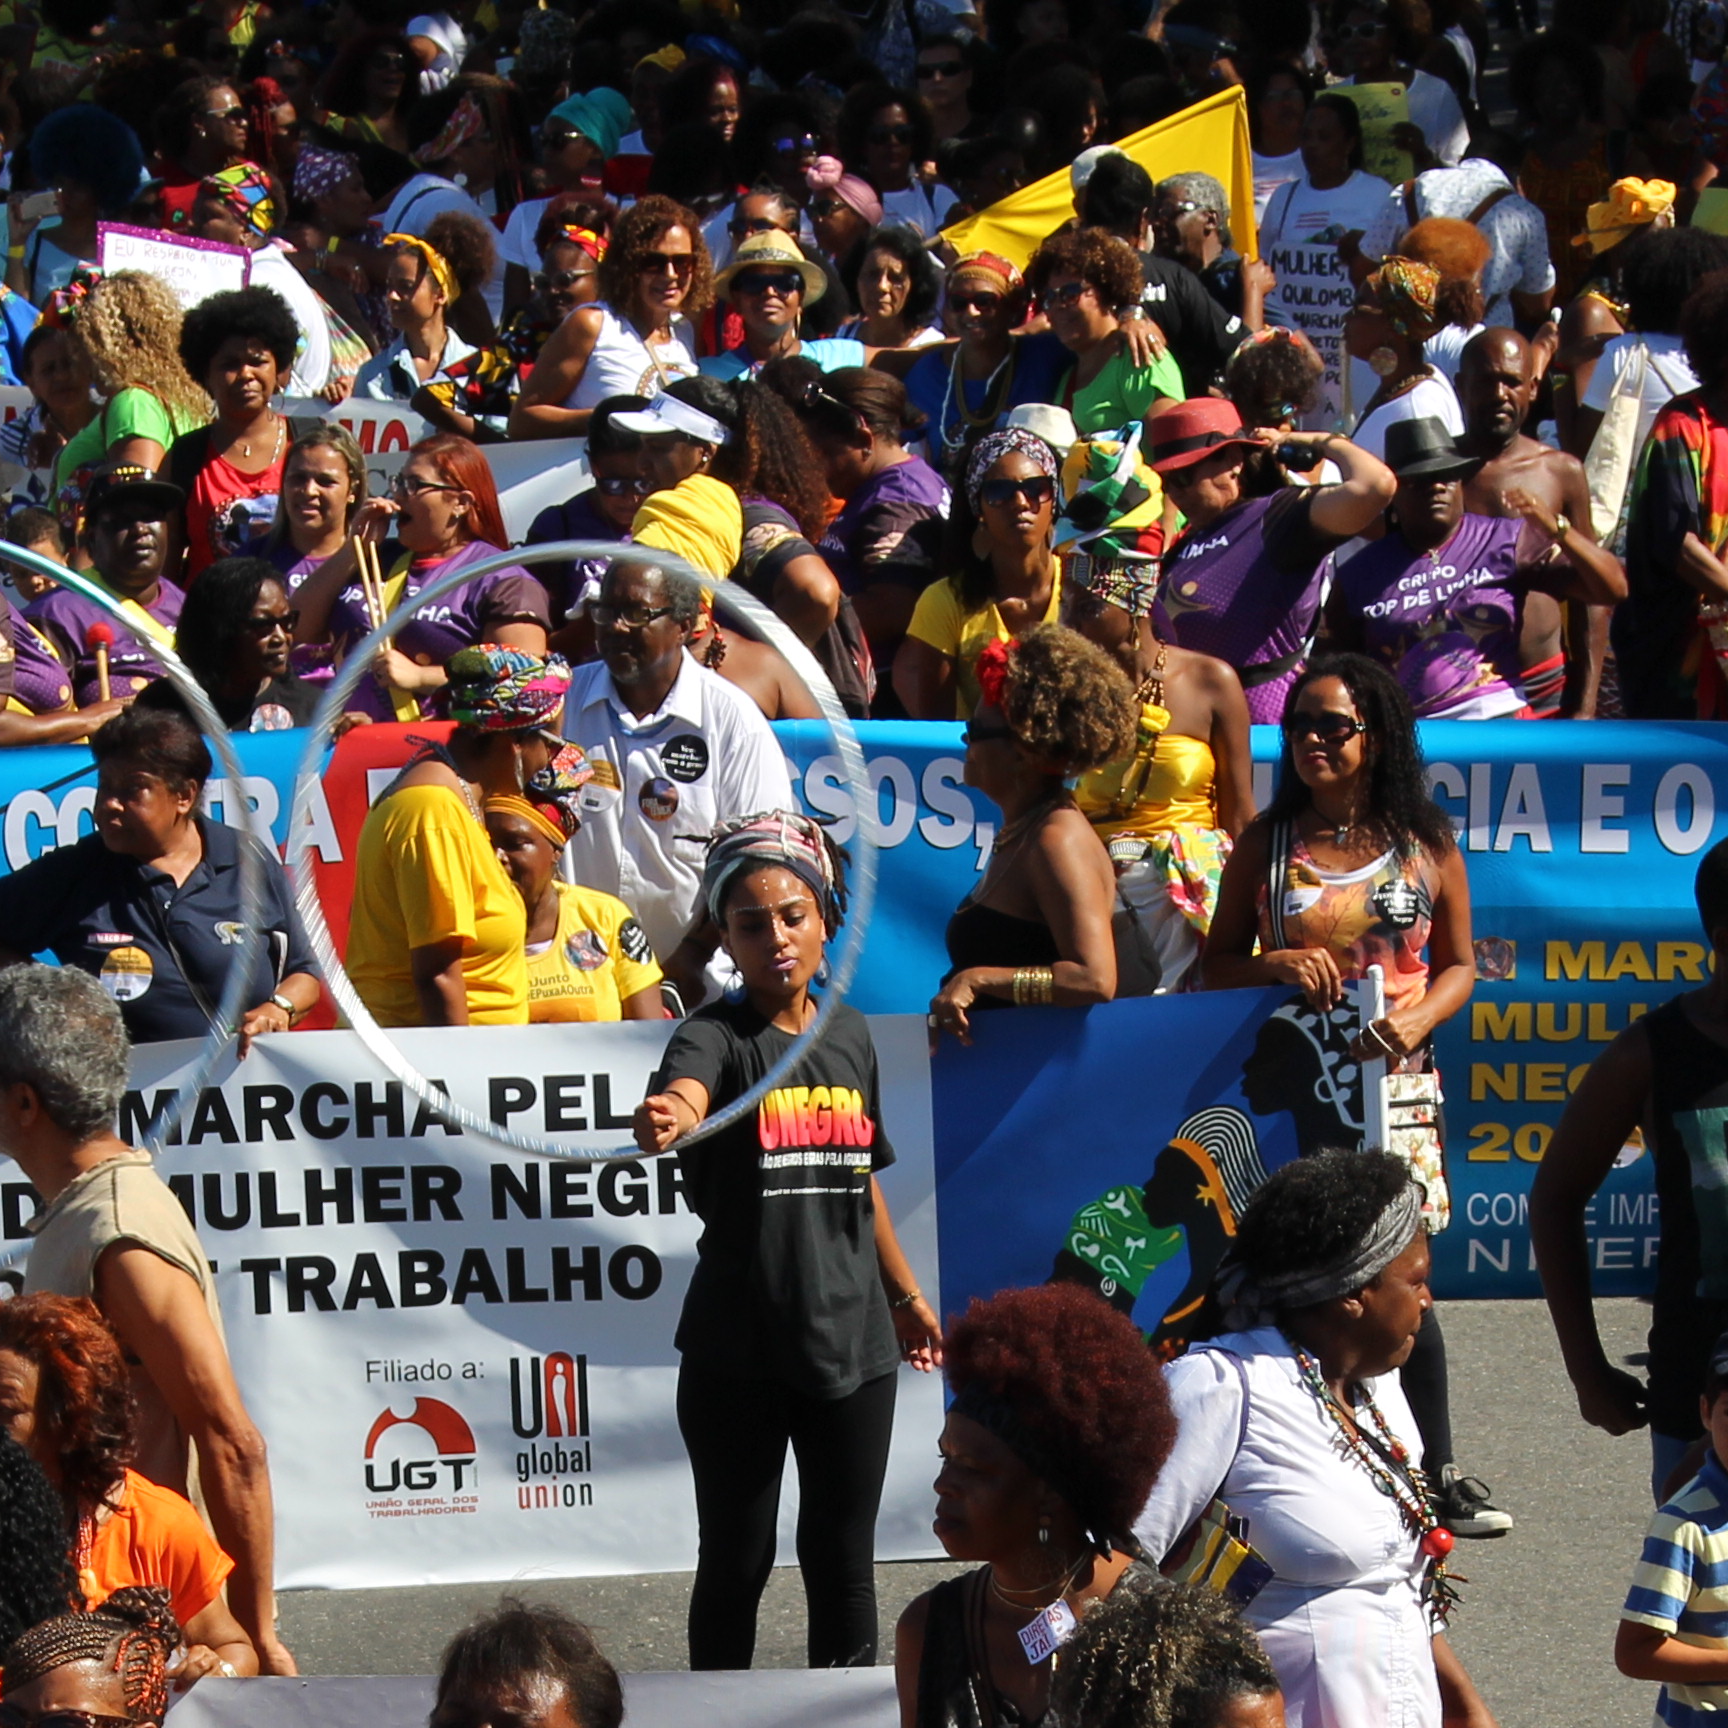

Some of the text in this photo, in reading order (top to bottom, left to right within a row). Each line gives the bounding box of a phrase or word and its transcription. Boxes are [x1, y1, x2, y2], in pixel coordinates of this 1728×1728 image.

[1281, 284, 1352, 308] QUILOMB
[1402, 592, 1431, 611] DE
[1580, 764, 1633, 854] E
[1653, 762, 1715, 854] O
[120, 1075, 462, 1149] MARCHA
[758, 1085, 875, 1150] UNEGRO
[492, 1158, 699, 1222] NEGR
[252, 1243, 663, 1315] TRABALHO
[365, 1359, 485, 1384] Filiado a:
[364, 1458, 477, 1493] UGT
[516, 1441, 591, 1482] global
[365, 1495, 478, 1509] UNIÃO GERAL DOS
[368, 1504, 477, 1519] TRABALHADORES
[517, 1477, 593, 1509] union
[1020, 1606, 1063, 1646] DIRETAS
